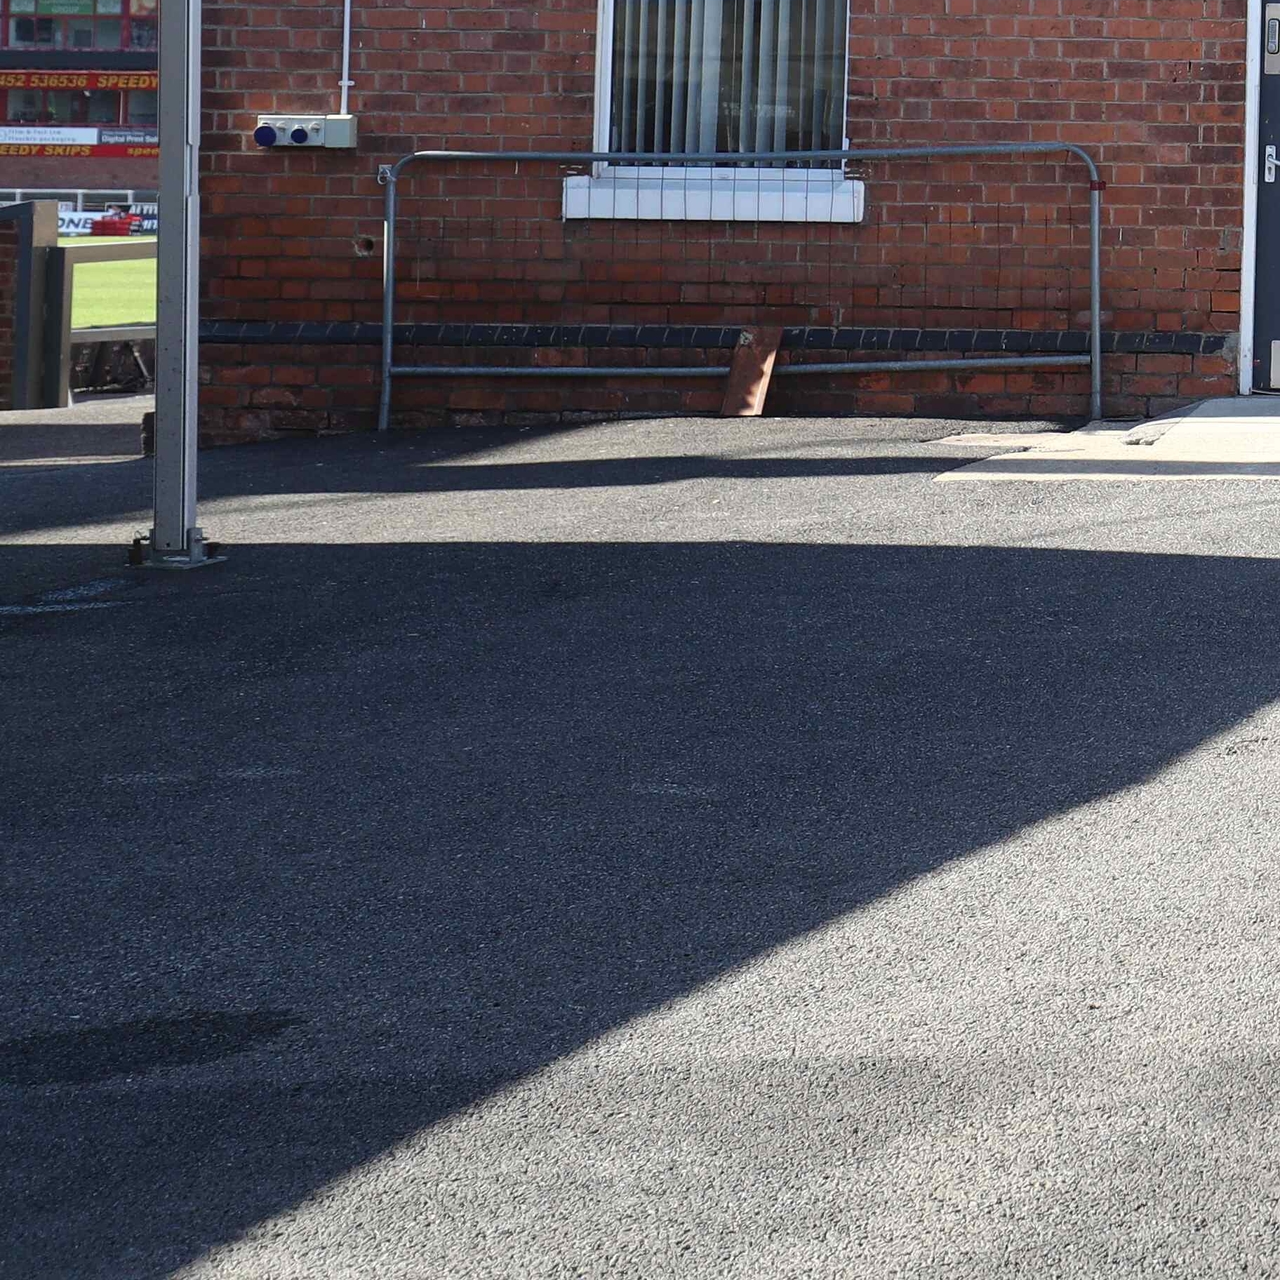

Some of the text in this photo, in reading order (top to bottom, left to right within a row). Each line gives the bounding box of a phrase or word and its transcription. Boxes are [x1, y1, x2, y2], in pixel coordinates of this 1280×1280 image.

[30, 75, 87, 87] 536536
[97, 75, 159, 88] SPEEDY
[102, 135, 125, 144] Digital
[127, 135, 144, 143] Print
[44, 146, 92, 156] SKIPS
